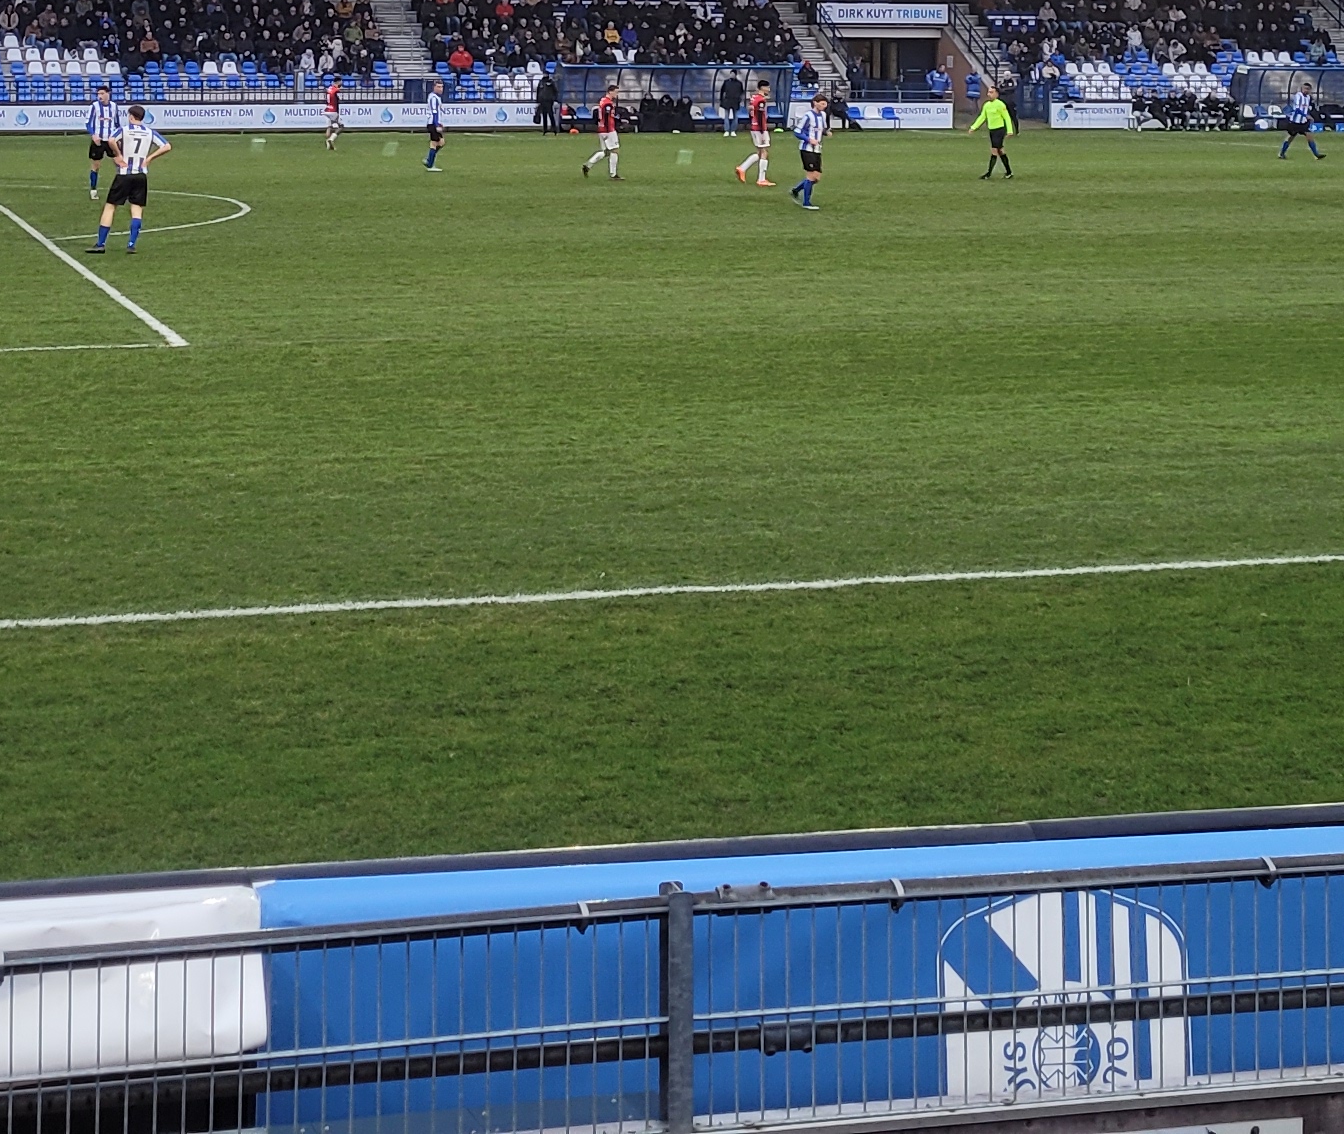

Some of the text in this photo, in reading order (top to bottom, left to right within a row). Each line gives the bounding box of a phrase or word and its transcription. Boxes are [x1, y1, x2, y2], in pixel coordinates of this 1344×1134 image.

[838, 8, 943, 19] DIRK KUYT TRIBUNE
[163, 109, 254, 118] MULTIDIENSTEN DM
[358, 108, 372, 116] DM
[473, 107, 487, 116] DM
[133, 138, 142, 154] 7
